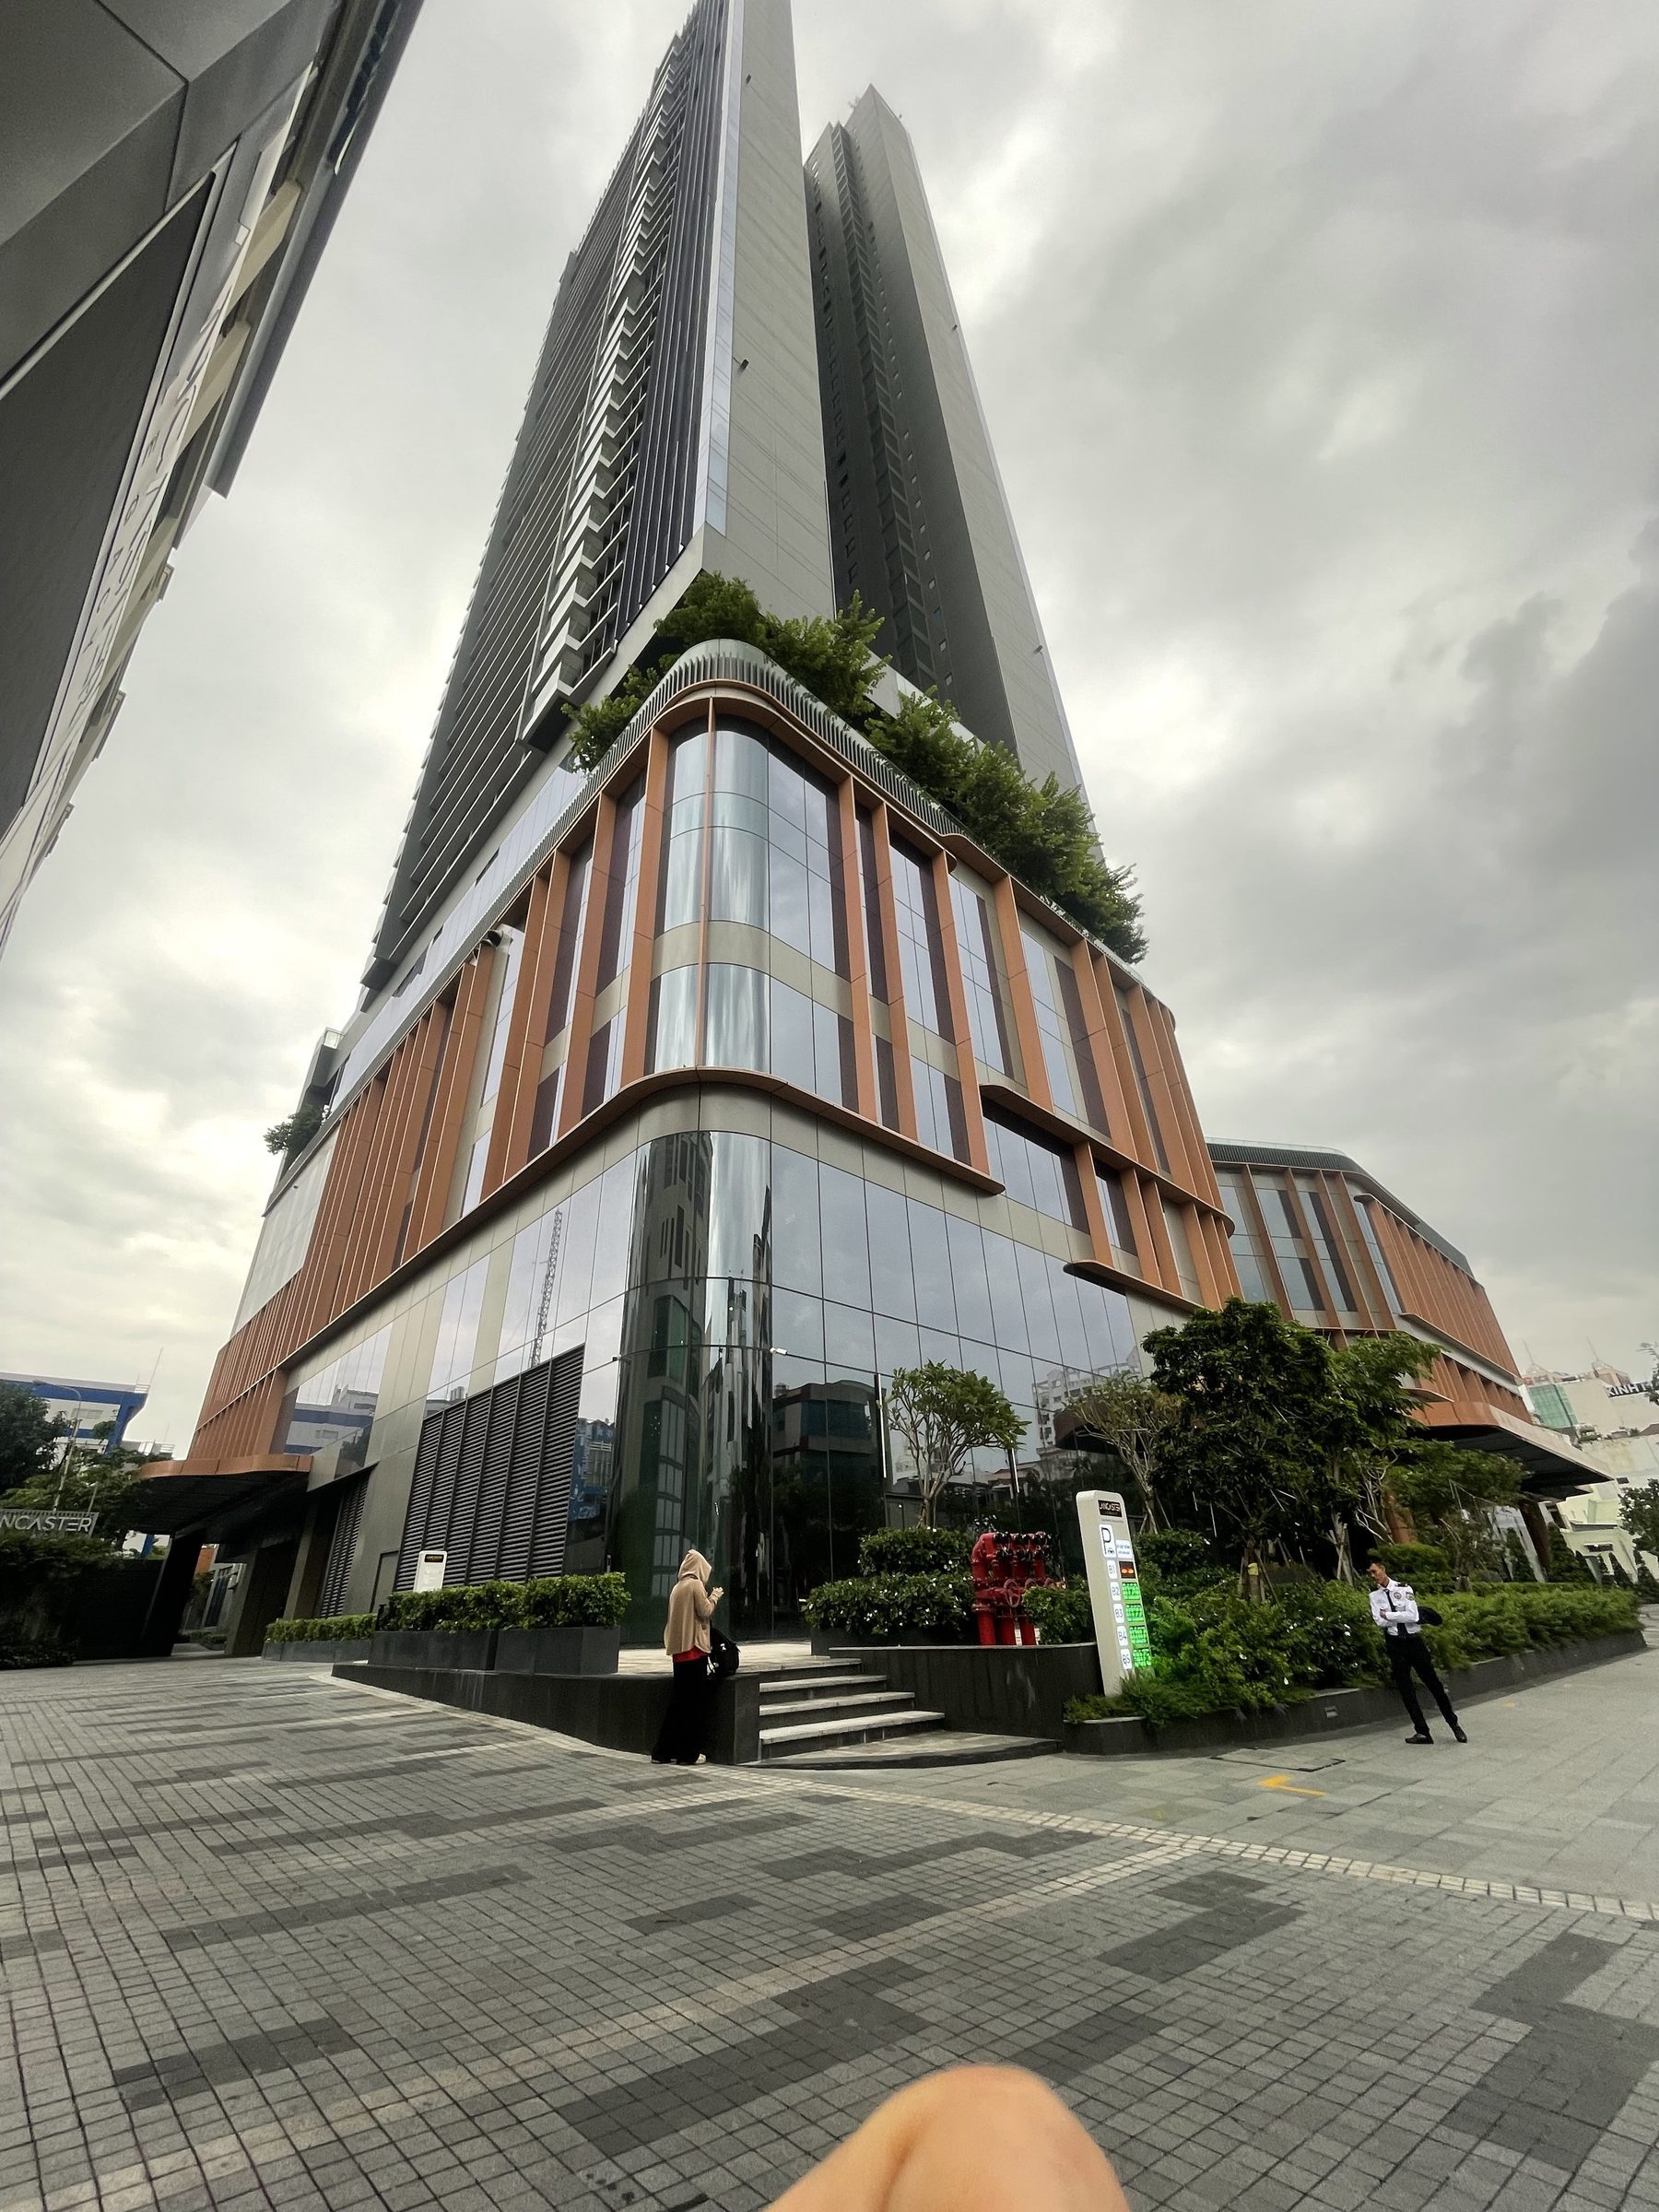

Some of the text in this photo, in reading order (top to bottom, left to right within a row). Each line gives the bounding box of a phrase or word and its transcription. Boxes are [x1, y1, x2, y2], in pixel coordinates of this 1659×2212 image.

[1607, 1382, 1640, 1396] KINH
[0, 1514, 92, 1532] NCASTER
[1112, 1586, 1120, 1596] B2
[1114, 1608, 1123, 1618] B3
[1118, 1631, 1126, 1641] B4
